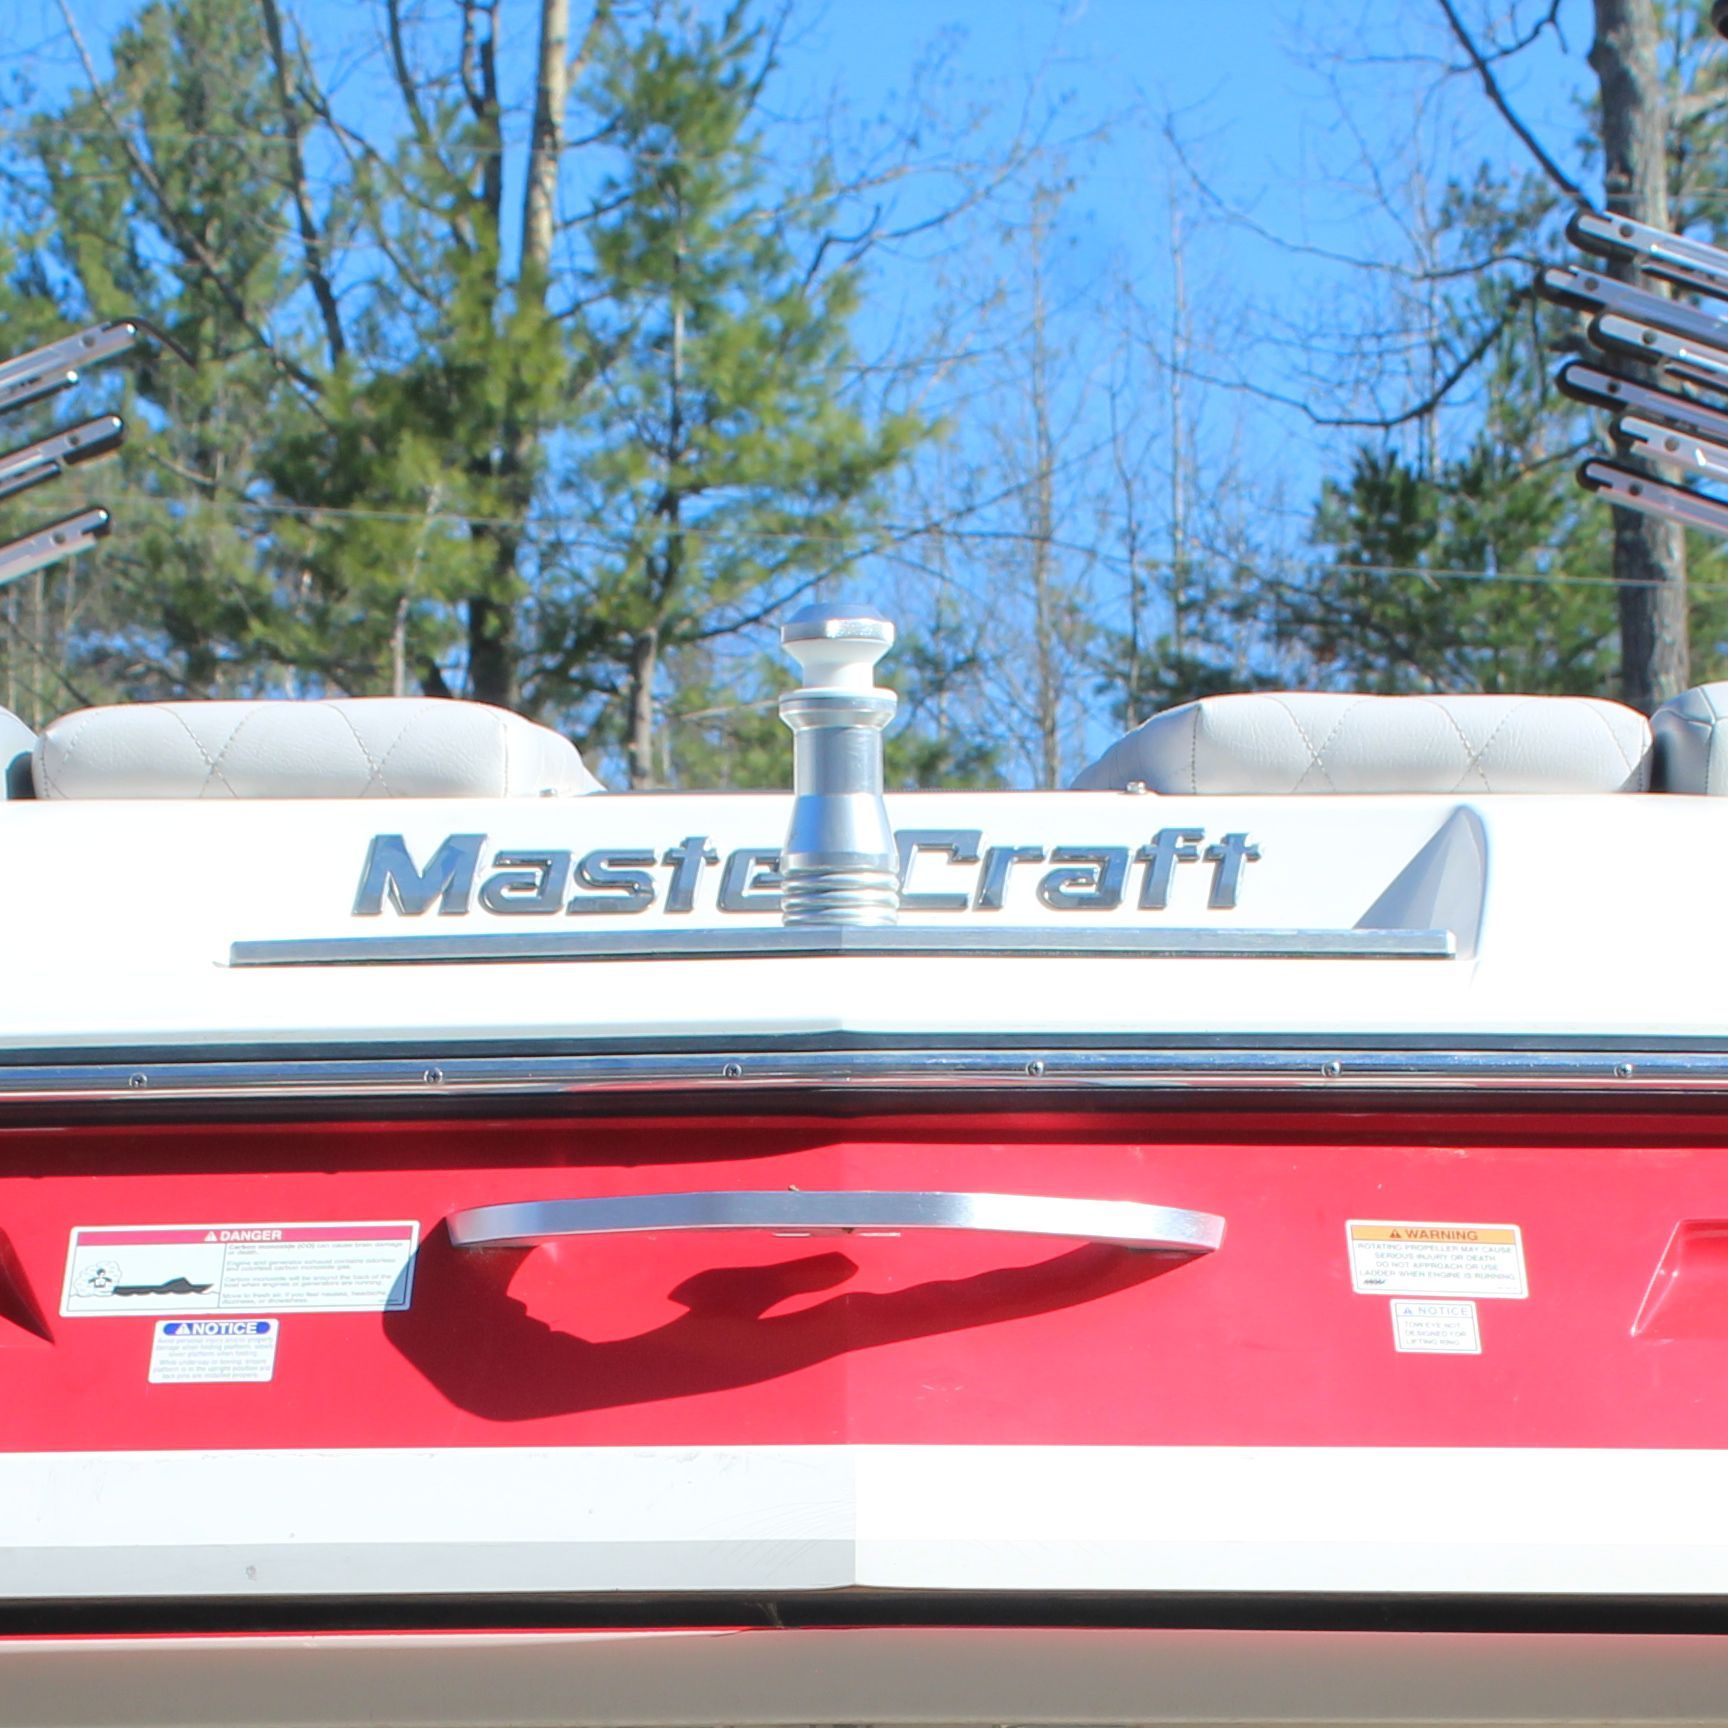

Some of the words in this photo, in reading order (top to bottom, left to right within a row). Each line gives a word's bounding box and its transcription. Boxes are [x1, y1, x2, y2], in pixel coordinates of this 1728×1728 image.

[352, 828, 1262, 917] MasteCraft
[219, 1229, 282, 1242] DANGER
[1405, 1228, 1479, 1241] WARNING
[1418, 1306, 1469, 1316] NOTICE
[192, 1322, 257, 1335] NOTICE
